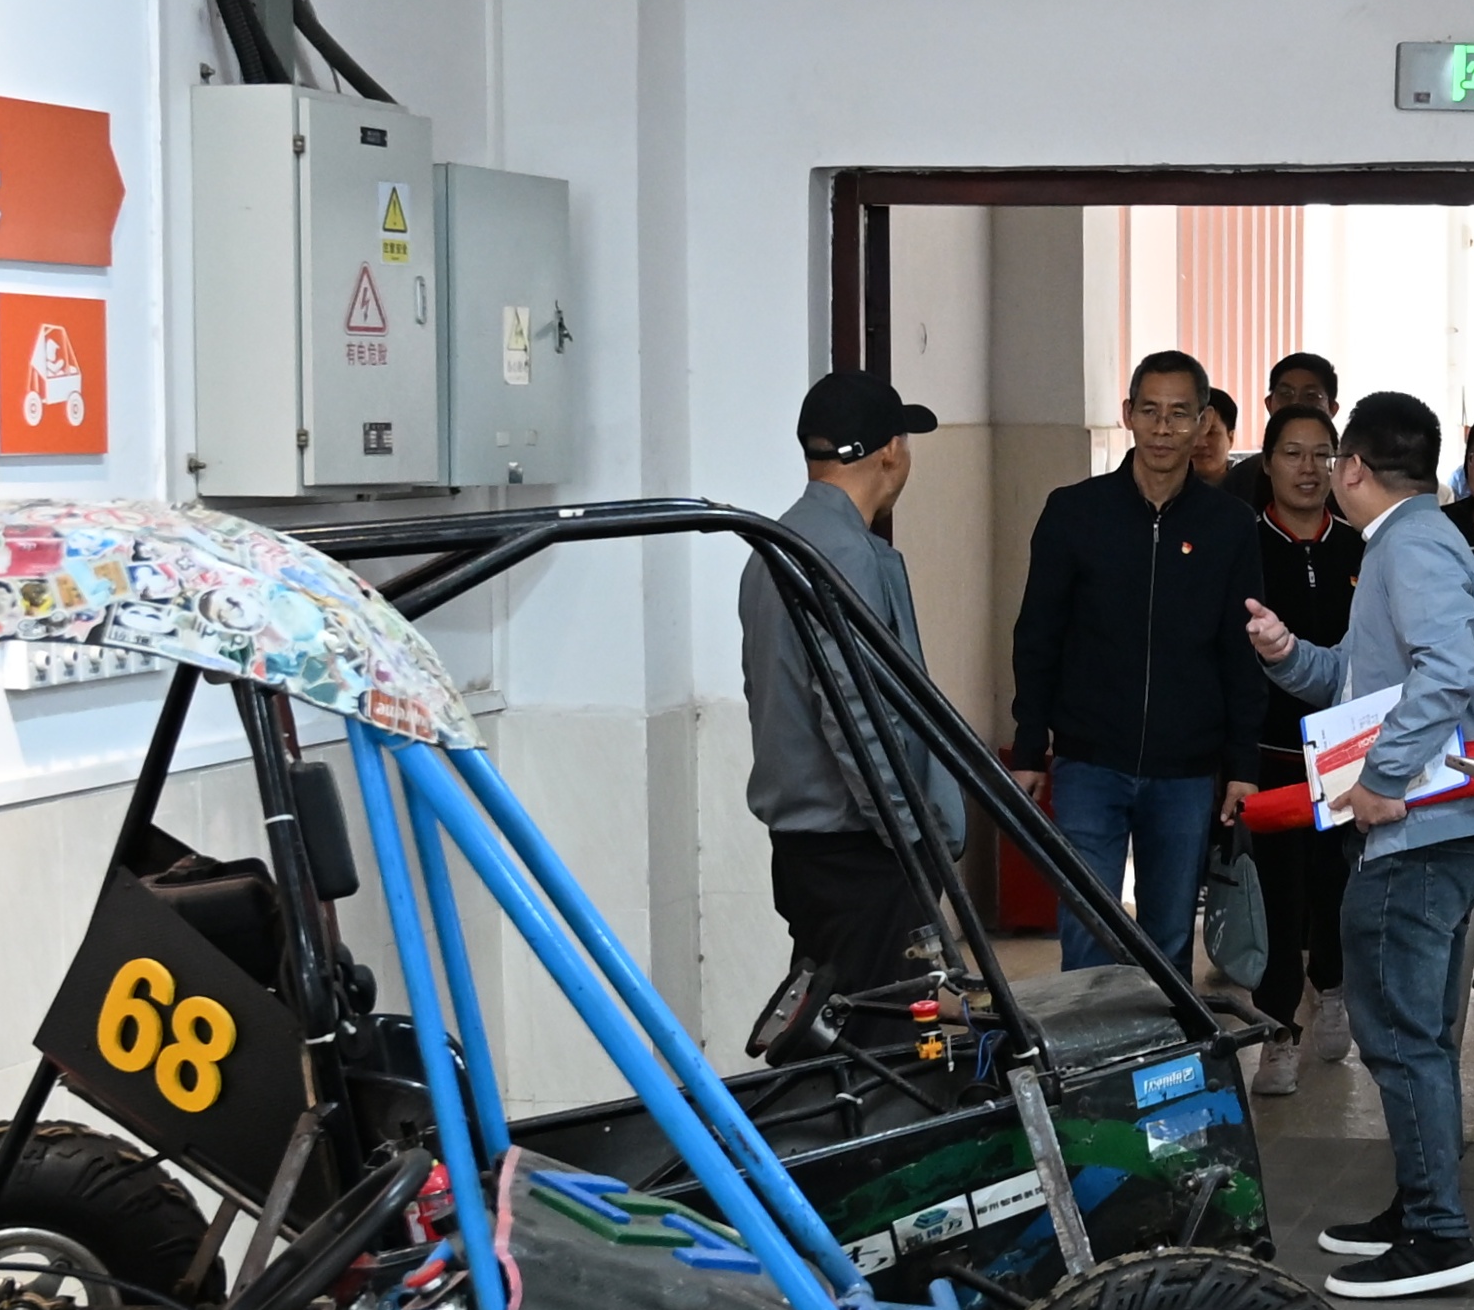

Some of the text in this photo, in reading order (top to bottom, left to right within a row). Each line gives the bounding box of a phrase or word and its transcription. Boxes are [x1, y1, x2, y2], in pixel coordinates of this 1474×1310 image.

[345, 342, 389, 366] 有电危险
[97, 957, 238, 1115] 68
